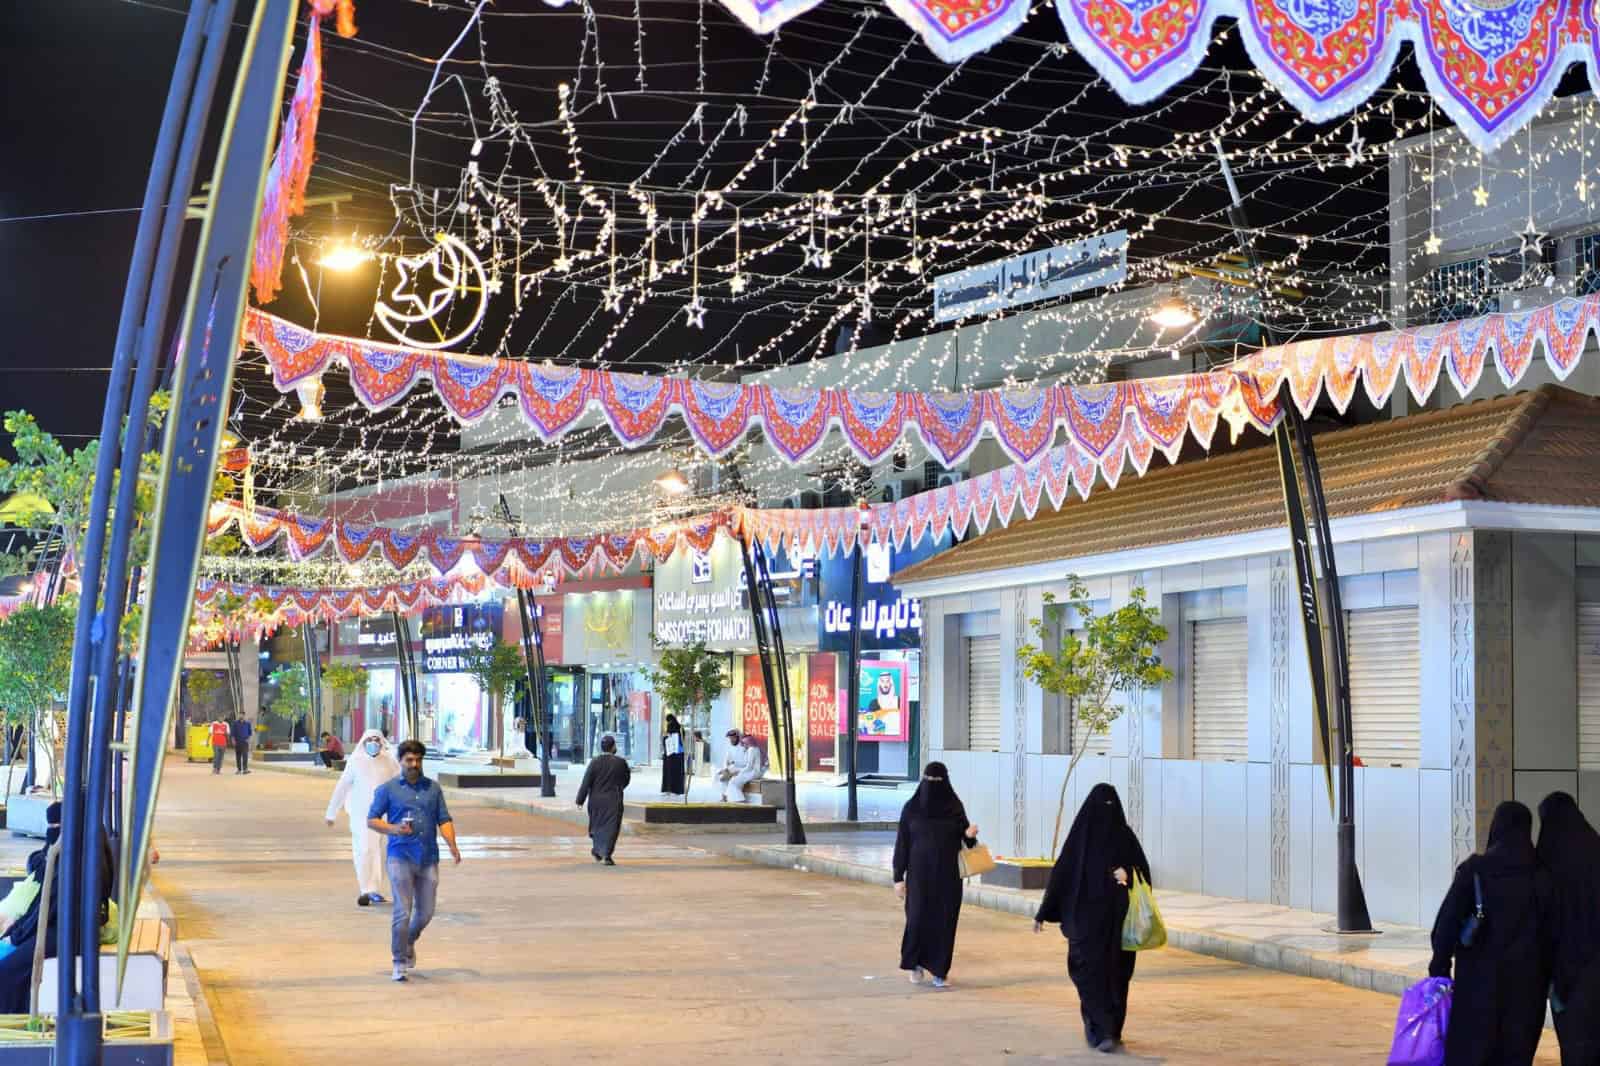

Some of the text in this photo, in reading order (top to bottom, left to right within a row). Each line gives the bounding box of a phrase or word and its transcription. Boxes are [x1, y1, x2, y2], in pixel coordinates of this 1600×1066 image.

[825, 599, 876, 633] للسعات
[707, 618, 721, 641] FOR
[744, 723, 769, 736] SALE
[810, 723, 836, 737] SALE
